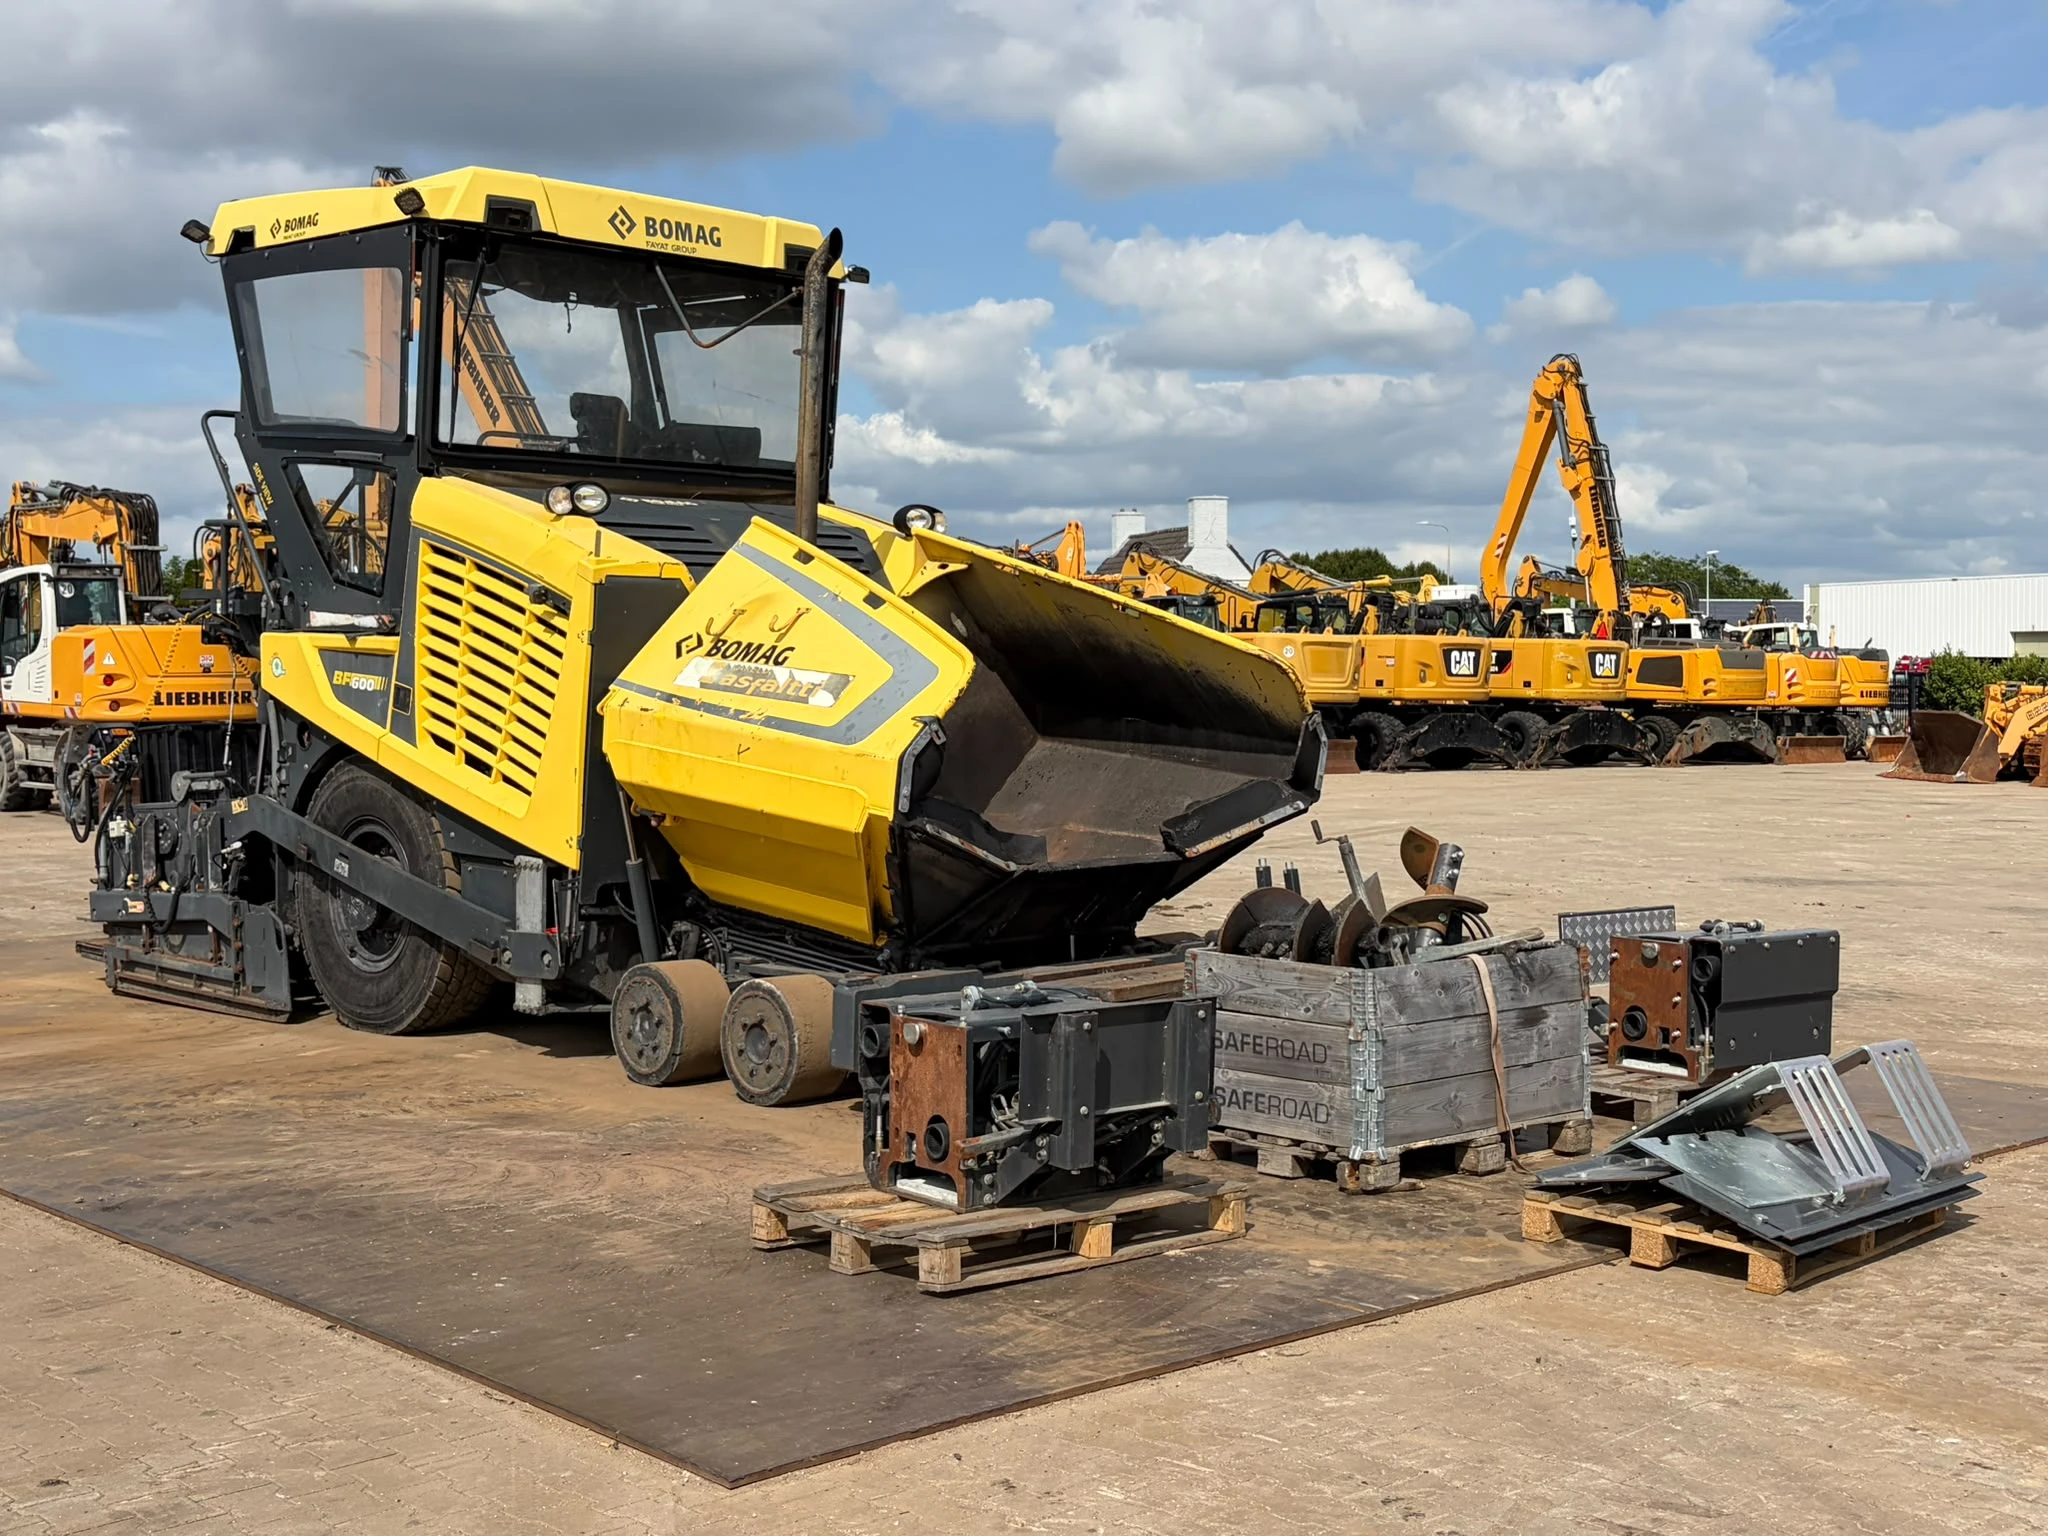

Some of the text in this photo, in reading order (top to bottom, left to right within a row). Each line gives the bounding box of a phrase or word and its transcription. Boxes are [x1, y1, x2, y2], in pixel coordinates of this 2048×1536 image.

[284, 212, 319, 233] BOMAG
[644, 216, 722, 247] BOMAG
[646, 240, 697, 254] FAYAT GROUP
[460, 342, 500, 428] IEBHERR
[1589, 485, 1607, 549] LIEBHERR
[62, 582, 73, 595] 20
[704, 638, 796, 667] BOMAG
[1450, 650, 1475, 675] CAT
[1595, 653, 1617, 676] CAT
[154, 690, 252, 706] LIEBHERR
[1215, 1029, 1328, 1064] SAFEROAD
[1214, 1086, 1331, 1124] SAFEROAD
